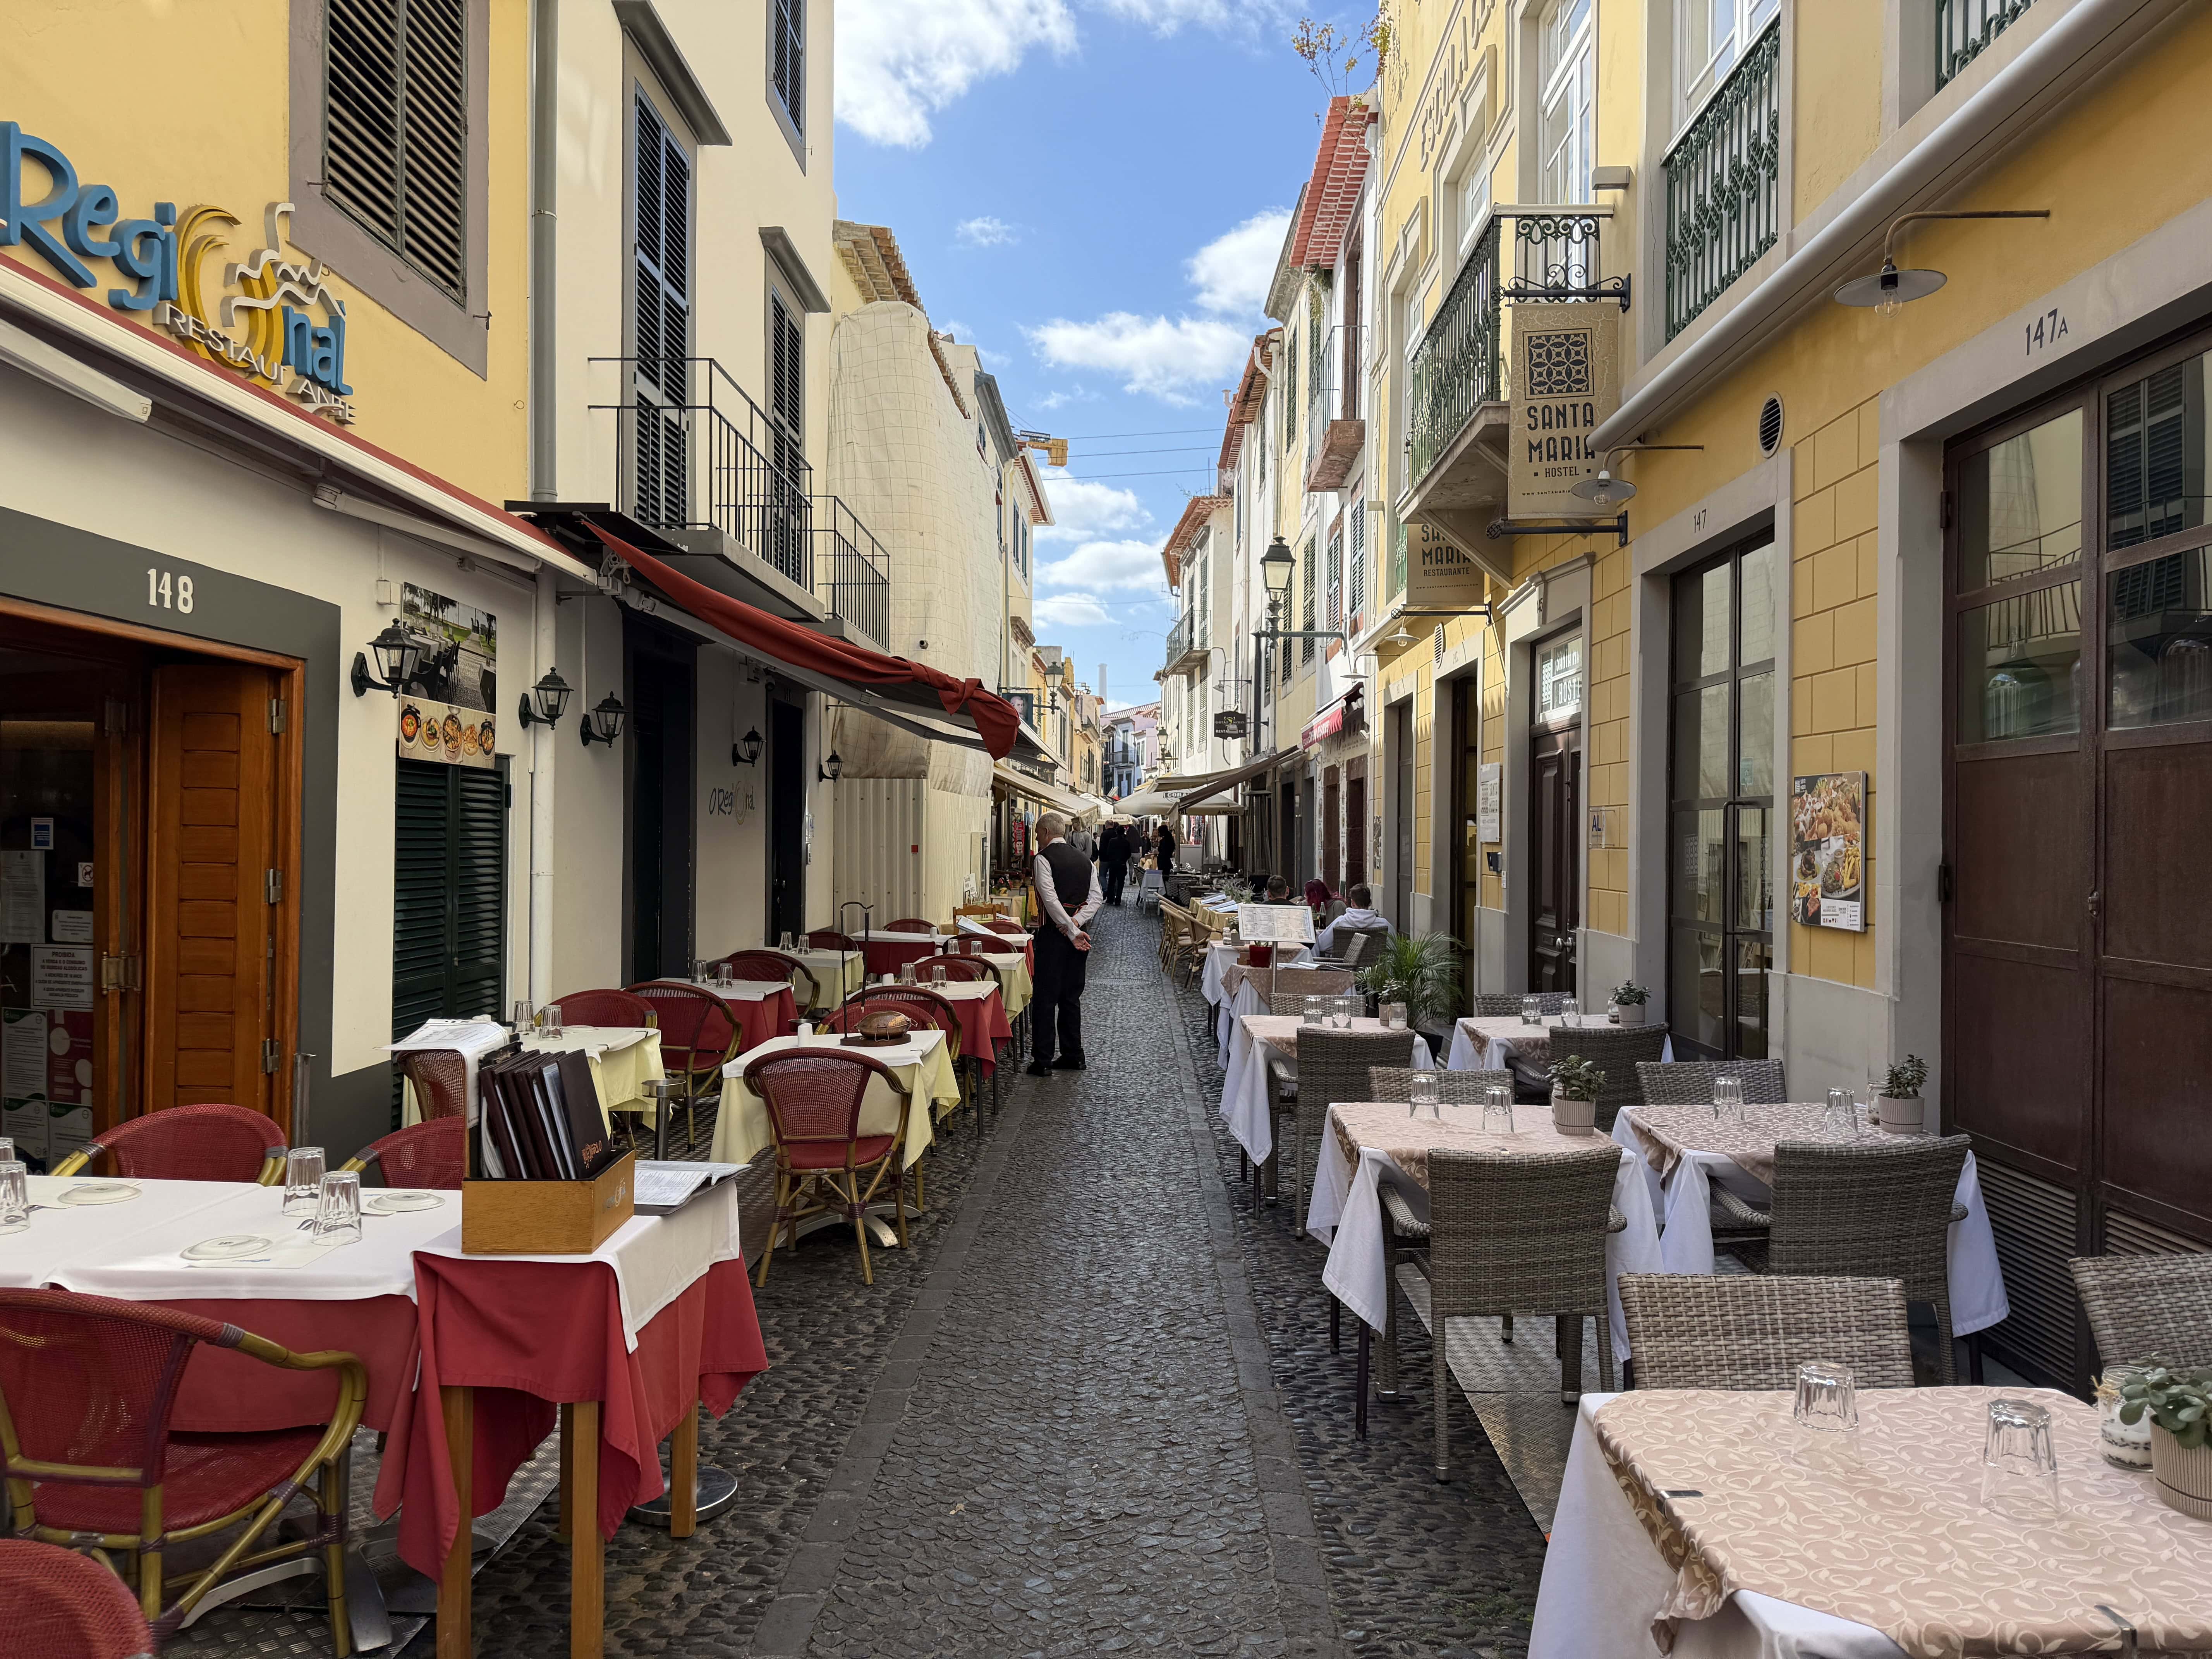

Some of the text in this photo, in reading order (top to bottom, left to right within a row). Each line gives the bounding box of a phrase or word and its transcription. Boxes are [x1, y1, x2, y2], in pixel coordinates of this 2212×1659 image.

[2026, 308, 2068, 356] 147A
[1527, 402, 1595, 431] SANTA
[1528, 434, 1595, 464] MARIA
[1545, 468, 1580, 477] HOSTEL
[1694, 509, 1706, 533] 147
[1424, 567, 1470, 577] RESTAURANTE
[147, 568, 193, 614] 148
[1559, 677, 1580, 704] HOSTE
[709, 787, 716, 815] O
[1592, 815, 1602, 831] AL
